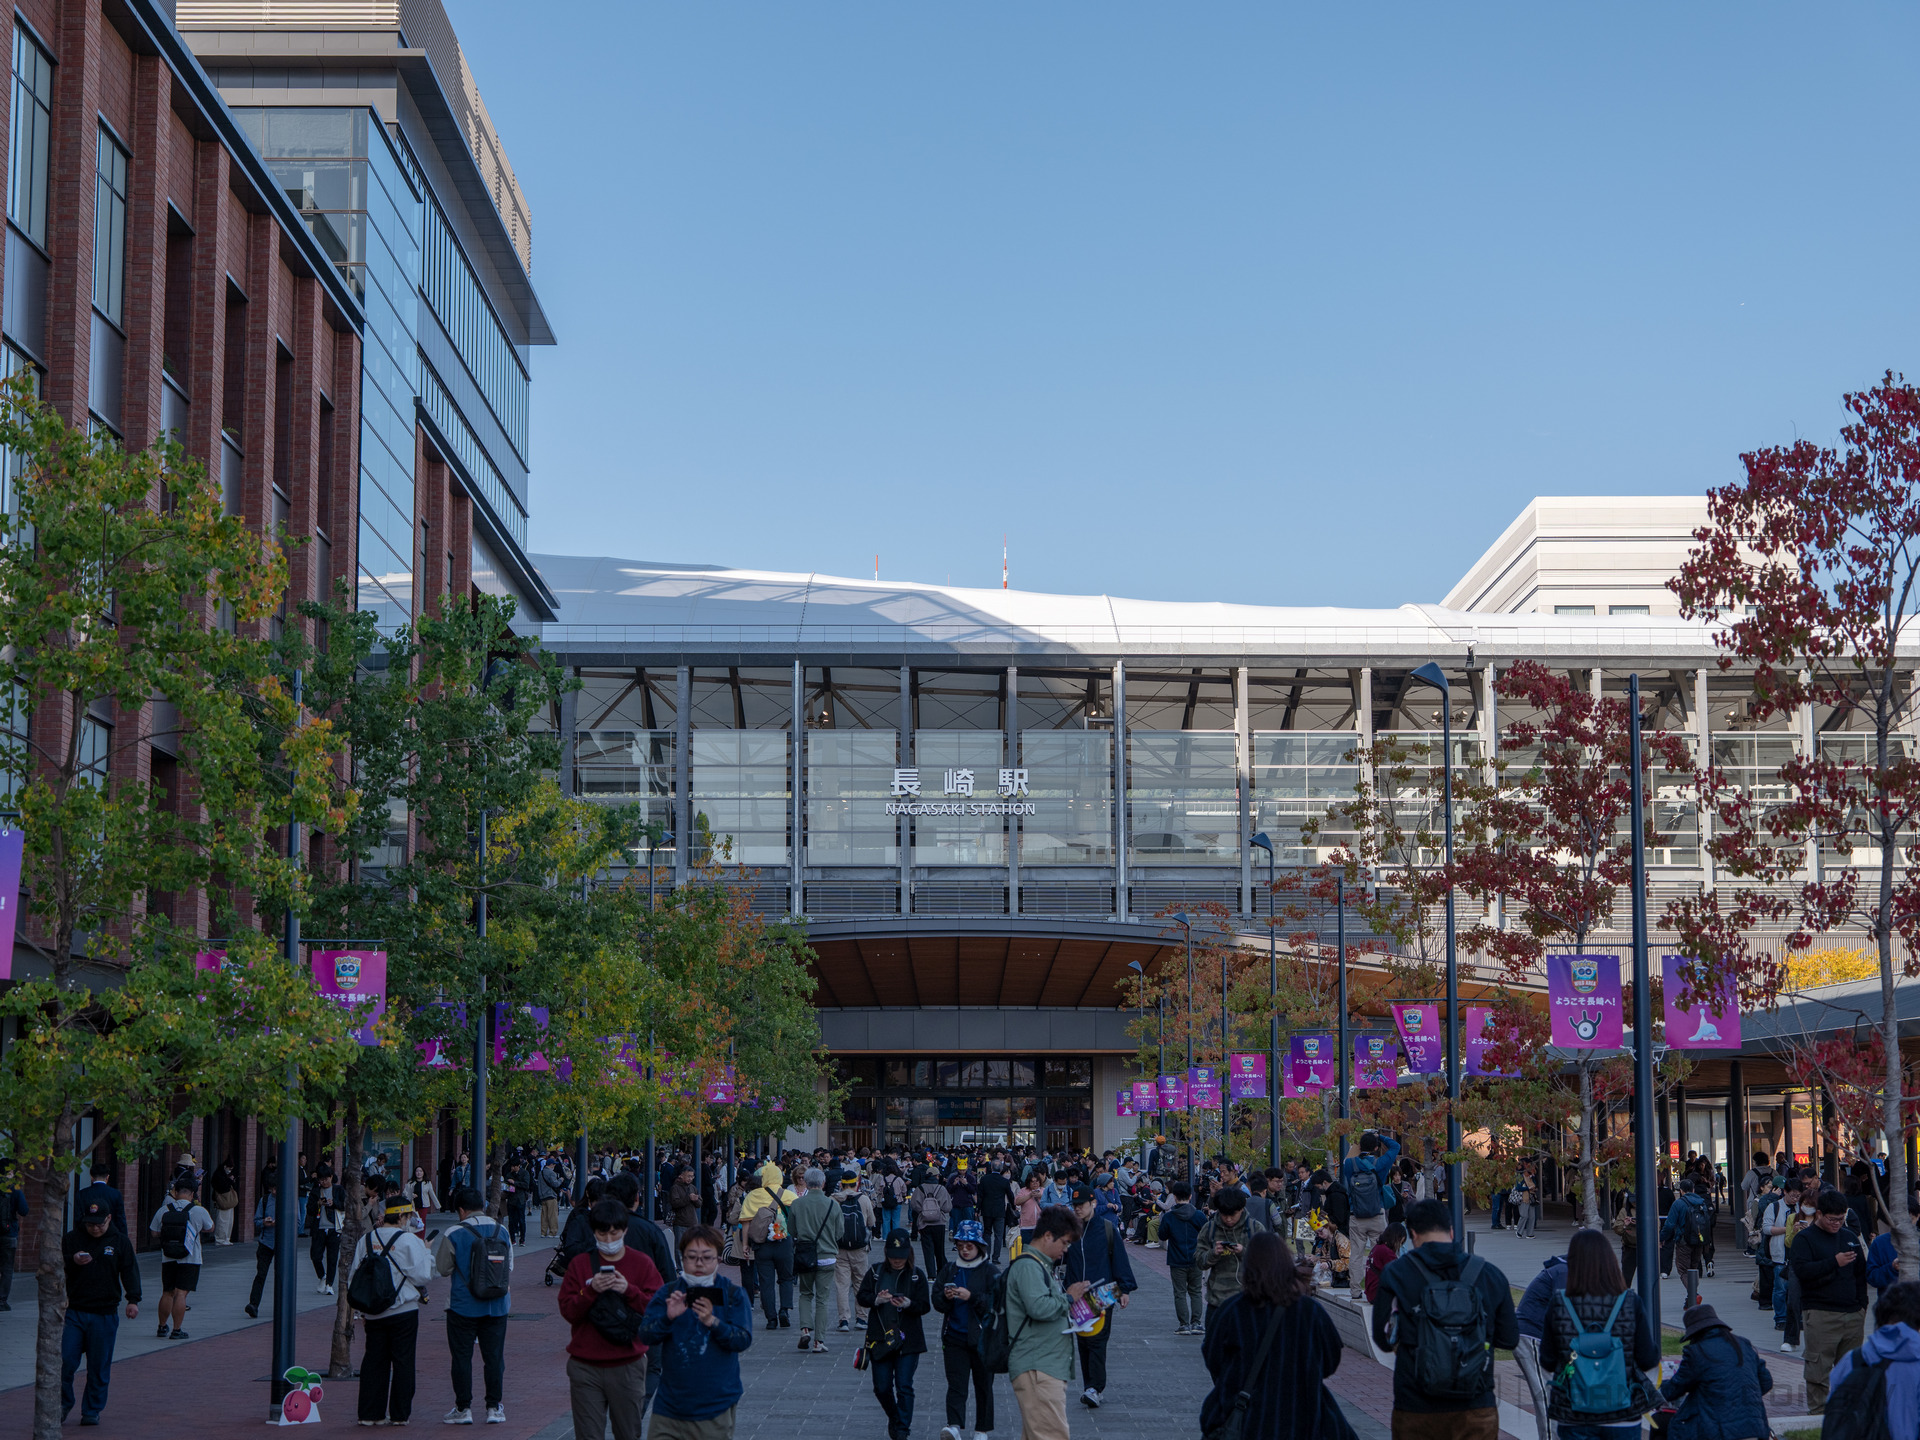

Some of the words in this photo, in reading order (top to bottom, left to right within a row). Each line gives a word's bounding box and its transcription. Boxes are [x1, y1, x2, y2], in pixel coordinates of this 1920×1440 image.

[890, 768, 1030, 797] 長崎駅
[885, 803, 965, 815] NAGASAKI
[970, 803, 1035, 815] STATION
